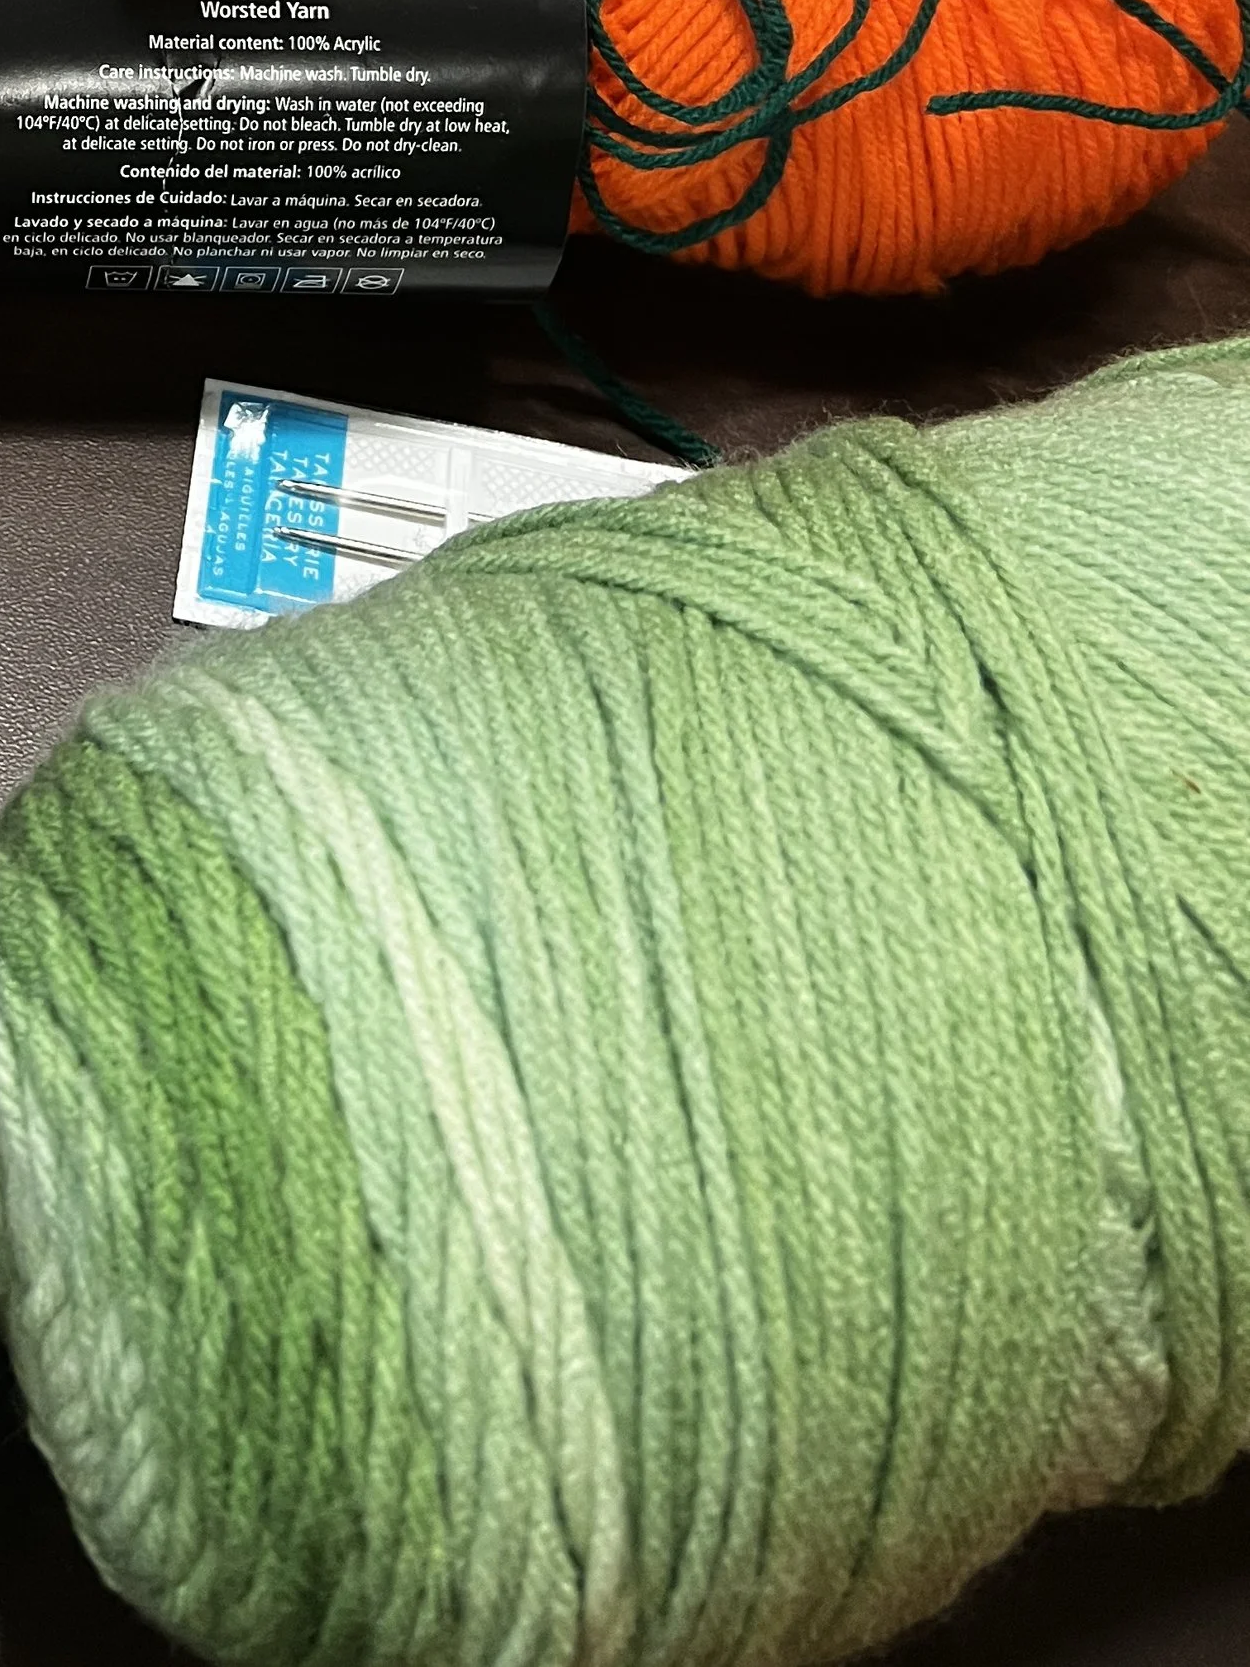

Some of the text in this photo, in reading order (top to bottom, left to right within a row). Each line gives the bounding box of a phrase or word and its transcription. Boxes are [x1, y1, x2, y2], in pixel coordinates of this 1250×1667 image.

[200, 1, 330, 19] Worsted Yarn
[149, 34, 381, 55] Material content: 100% Acrylic
[99, 64, 431, 86] Care instructions: Machine wash. Tumble dry.
[44, 94, 485, 117] Machine washing and drying: Wash in water (not exceeding
[105, 118, 119, 130] at
[123, 116, 179, 130] delicate
[182, 117, 236, 134] setting.
[239, 117, 259, 131] Do
[263, 118, 286, 132] not
[291, 116, 341, 132] bleach.
[345, 117, 395, 132] Tumble
[399, 117, 421, 135] dry
[426, 119, 440, 132] at
[444, 118, 470, 133] low
[475, 118, 510, 135] heat,
[62, 136, 462, 156] at delicate setting. Do not iron or press. Do not dry-clean.
[120, 165, 401, 179] Contenido del material: 100% acrílico
[31, 191, 483, 209] Instrucciones de Cuidado: Lavar a máquina. Secar en secadora.
[14, 216, 69, 228] Lavado
[73, 218, 82, 231] y
[86, 216, 139, 228] secado
[143, 218, 153, 228] a
[157, 216, 228, 231] máquina:
[232, 218, 269, 229] Lavar
[273, 219, 289, 229] en
[293, 219, 328, 232] agua
[333, 218, 355, 231] (no
[359, 218, 388, 229] más
[392, 218, 409, 229] de
[2, 233, 503, 247] en ciclo delicado. No usar blanqueador. Secar en secadora a temperatura
[13, 246, 47, 257] baja,
[51, 247, 68, 256] en
[72, 246, 103, 257] ciclo
[172, 246, 193, 257] No
[196, 247, 257, 259] planchar
[260, 247, 274, 257] ni
[278, 248, 307, 257] usar
[310, 248, 351, 259] vapor.
[356, 247, 376, 258] No
[380, 248, 429, 260] limpiar
[432, 249, 449, 259] en
[453, 249, 486, 260] seco.
[234, 466, 255, 552] AIGUILLES
[212, 511, 231, 577] AGUJAS
